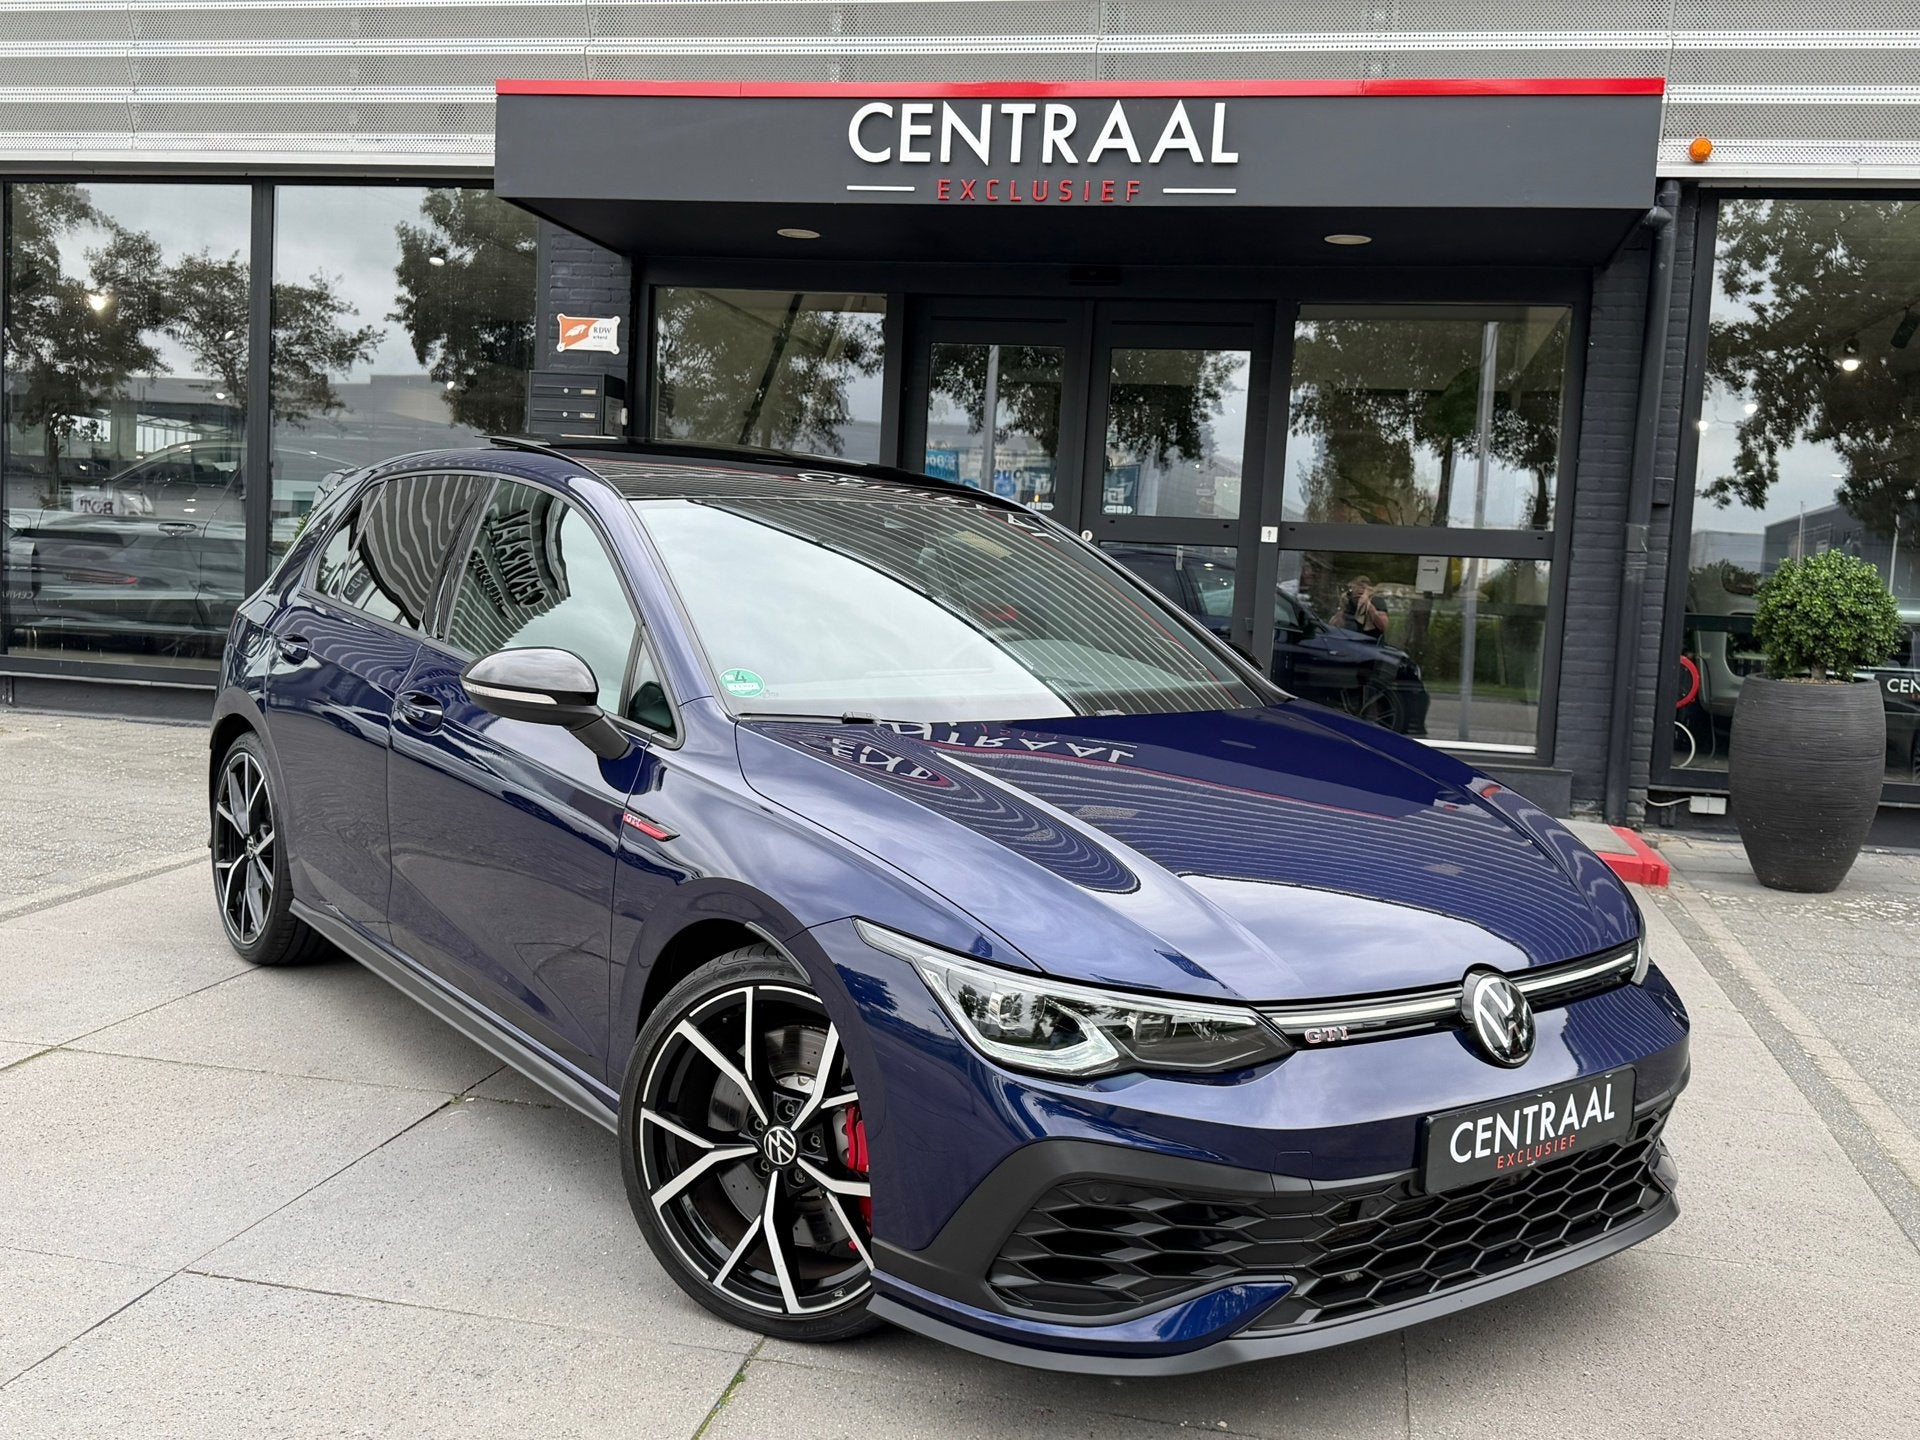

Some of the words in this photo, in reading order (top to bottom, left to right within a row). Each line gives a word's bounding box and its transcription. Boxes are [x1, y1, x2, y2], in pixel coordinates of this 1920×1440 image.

[848, 99, 1239, 166] CENTRAAL
[937, 178, 1142, 202] EXCLUSIEF
[593, 326, 612, 334] RDW
[1304, 1025, 1350, 1044] GTI
[1450, 1083, 1615, 1164] CENTRAAL
[1497, 1134, 1576, 1169] EXCLUSIEF
